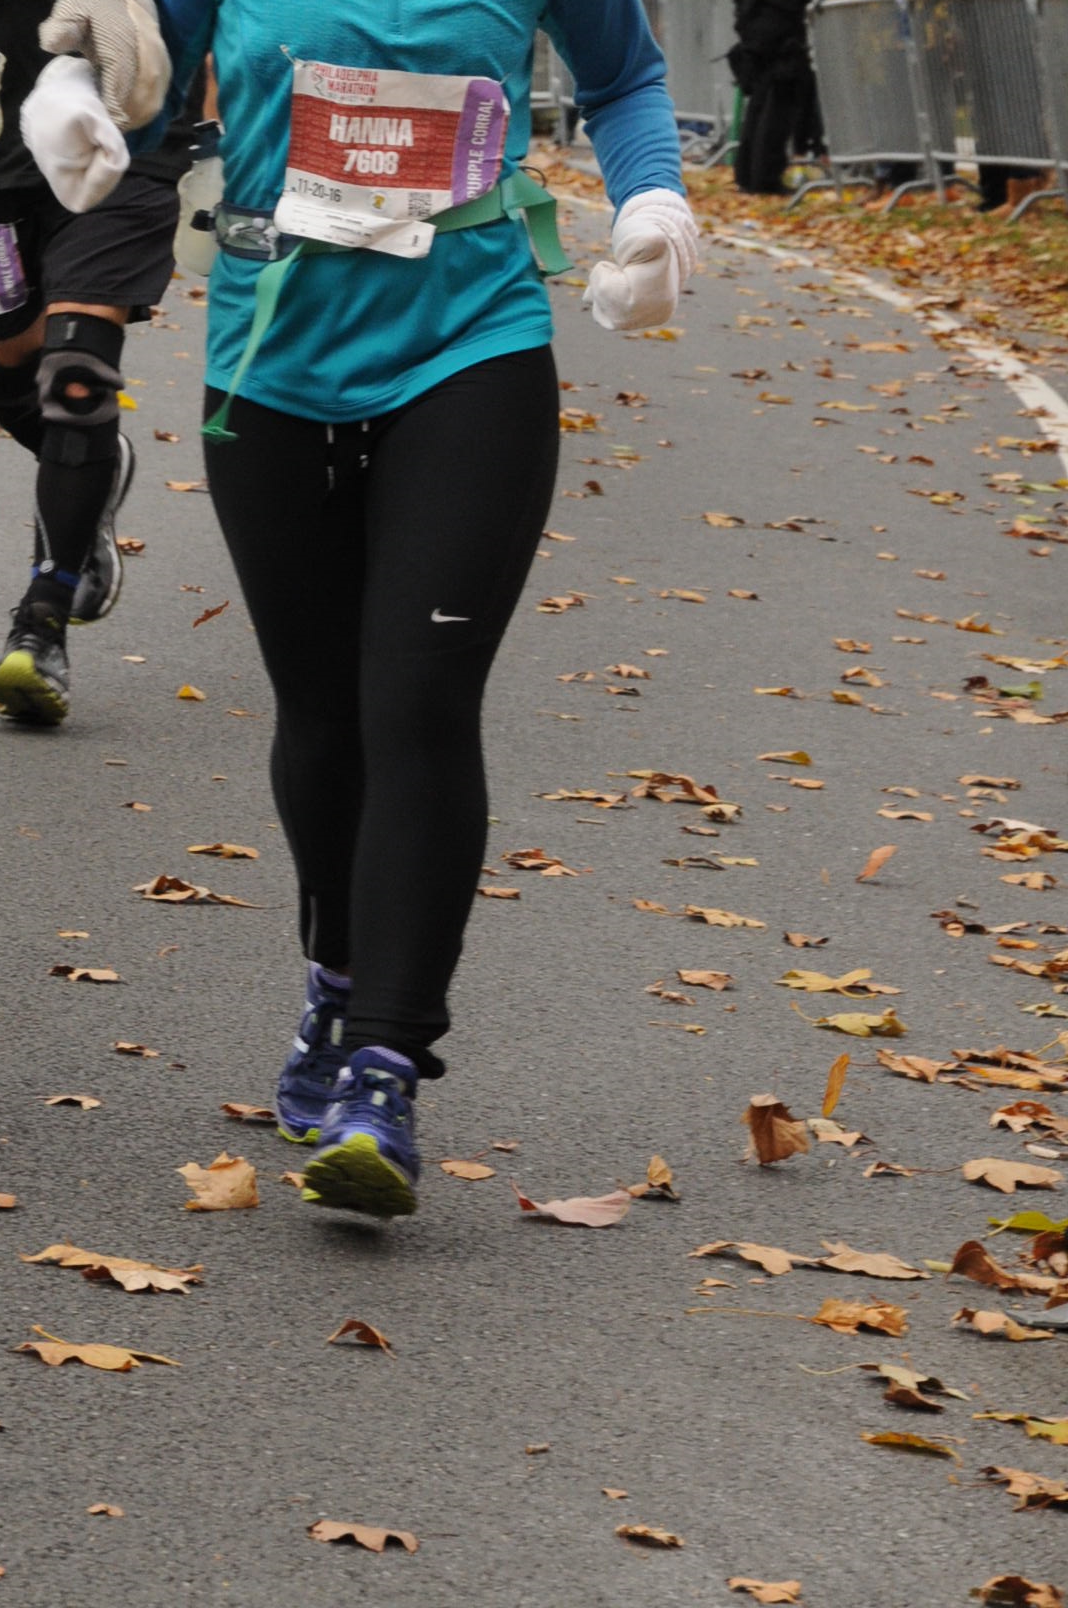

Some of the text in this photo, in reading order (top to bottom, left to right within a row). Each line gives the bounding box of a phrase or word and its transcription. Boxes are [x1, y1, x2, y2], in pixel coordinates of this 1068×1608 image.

[327, 80, 377, 96] MARATHON
[329, 114, 414, 147] HANNA
[343, 149, 400, 175] 7608
[466, 98, 494, 199] PURPLE CORRAL
[297, 177, 343, 204] 11-20-16
